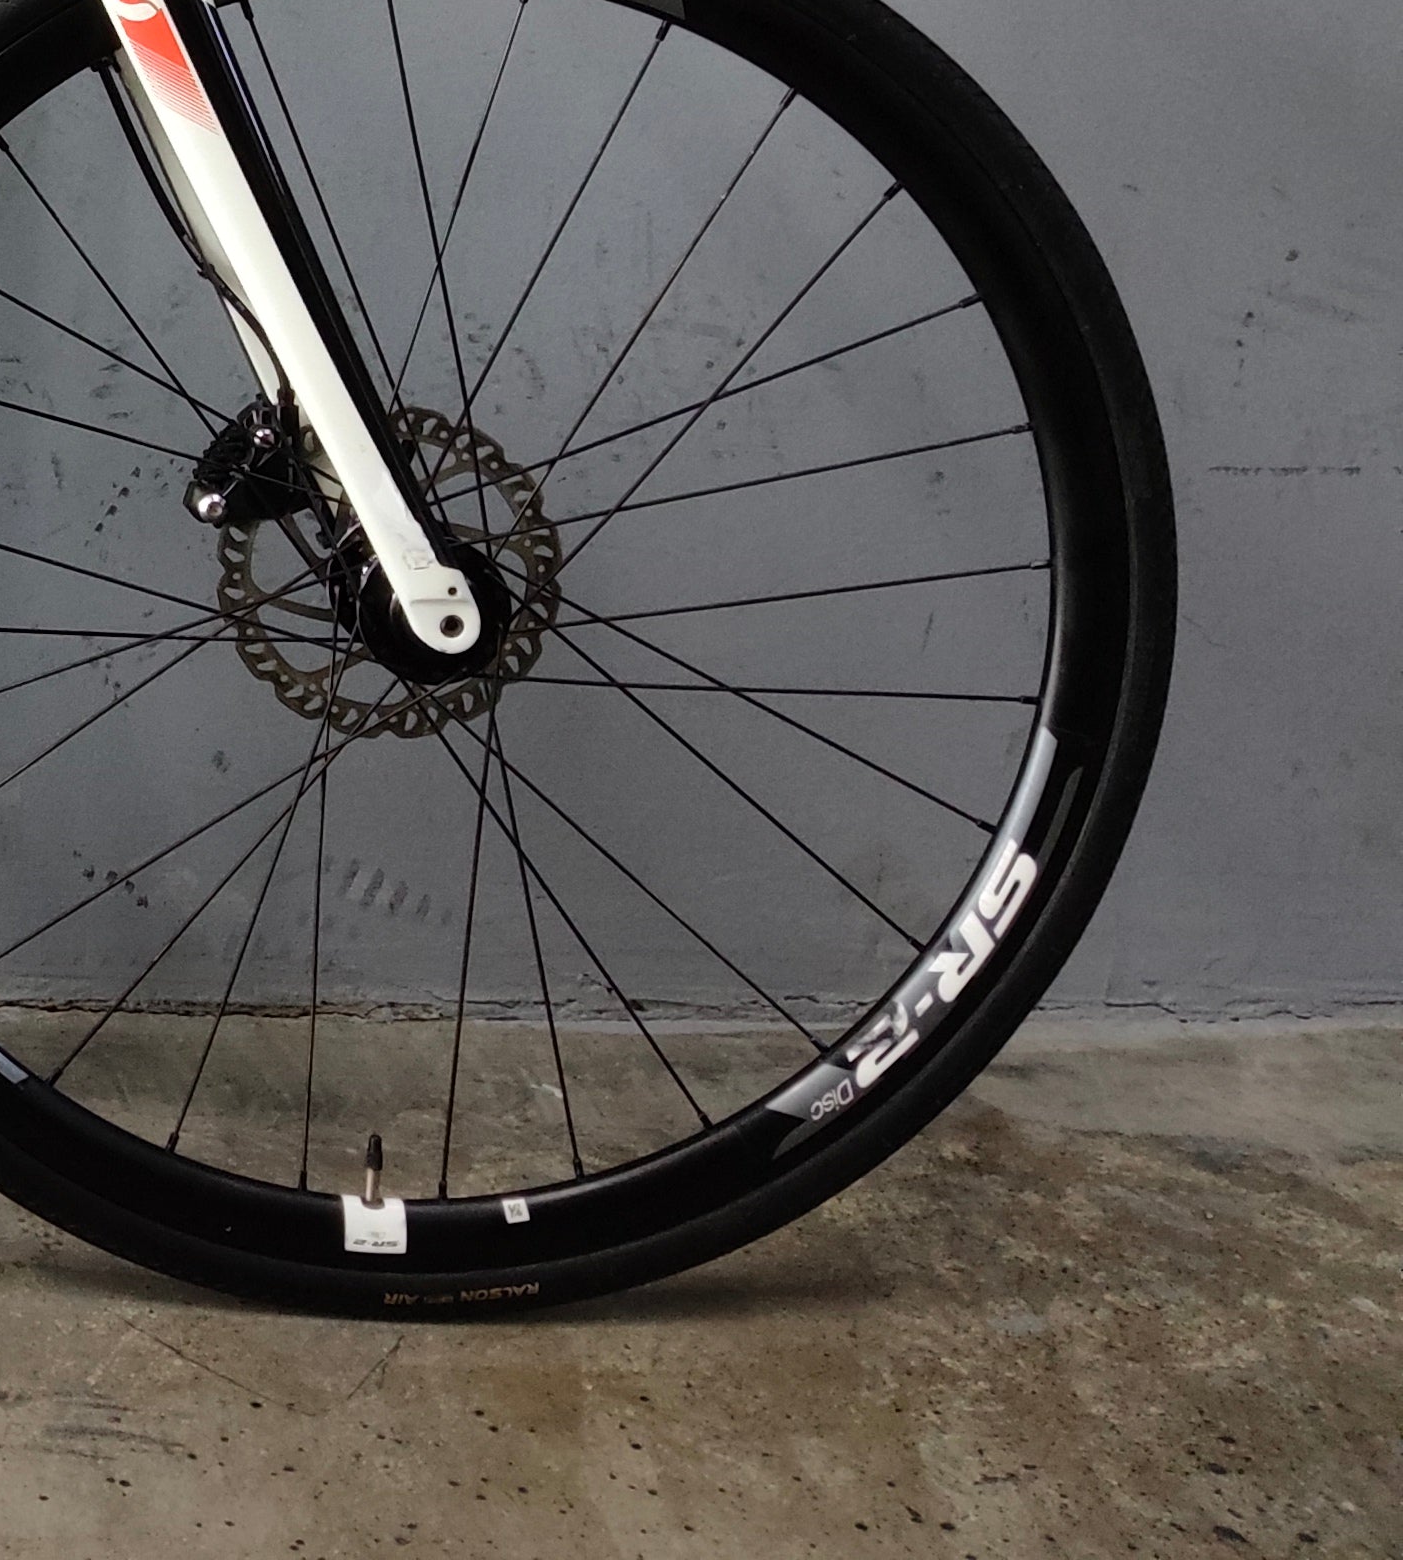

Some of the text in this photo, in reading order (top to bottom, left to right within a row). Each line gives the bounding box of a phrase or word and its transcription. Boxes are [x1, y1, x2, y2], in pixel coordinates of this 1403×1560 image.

[810, 839, 1038, 1122] SR-2 Disc
[383, 1292, 419, 1305] AIR
[460, 1282, 540, 1303] RALSON
